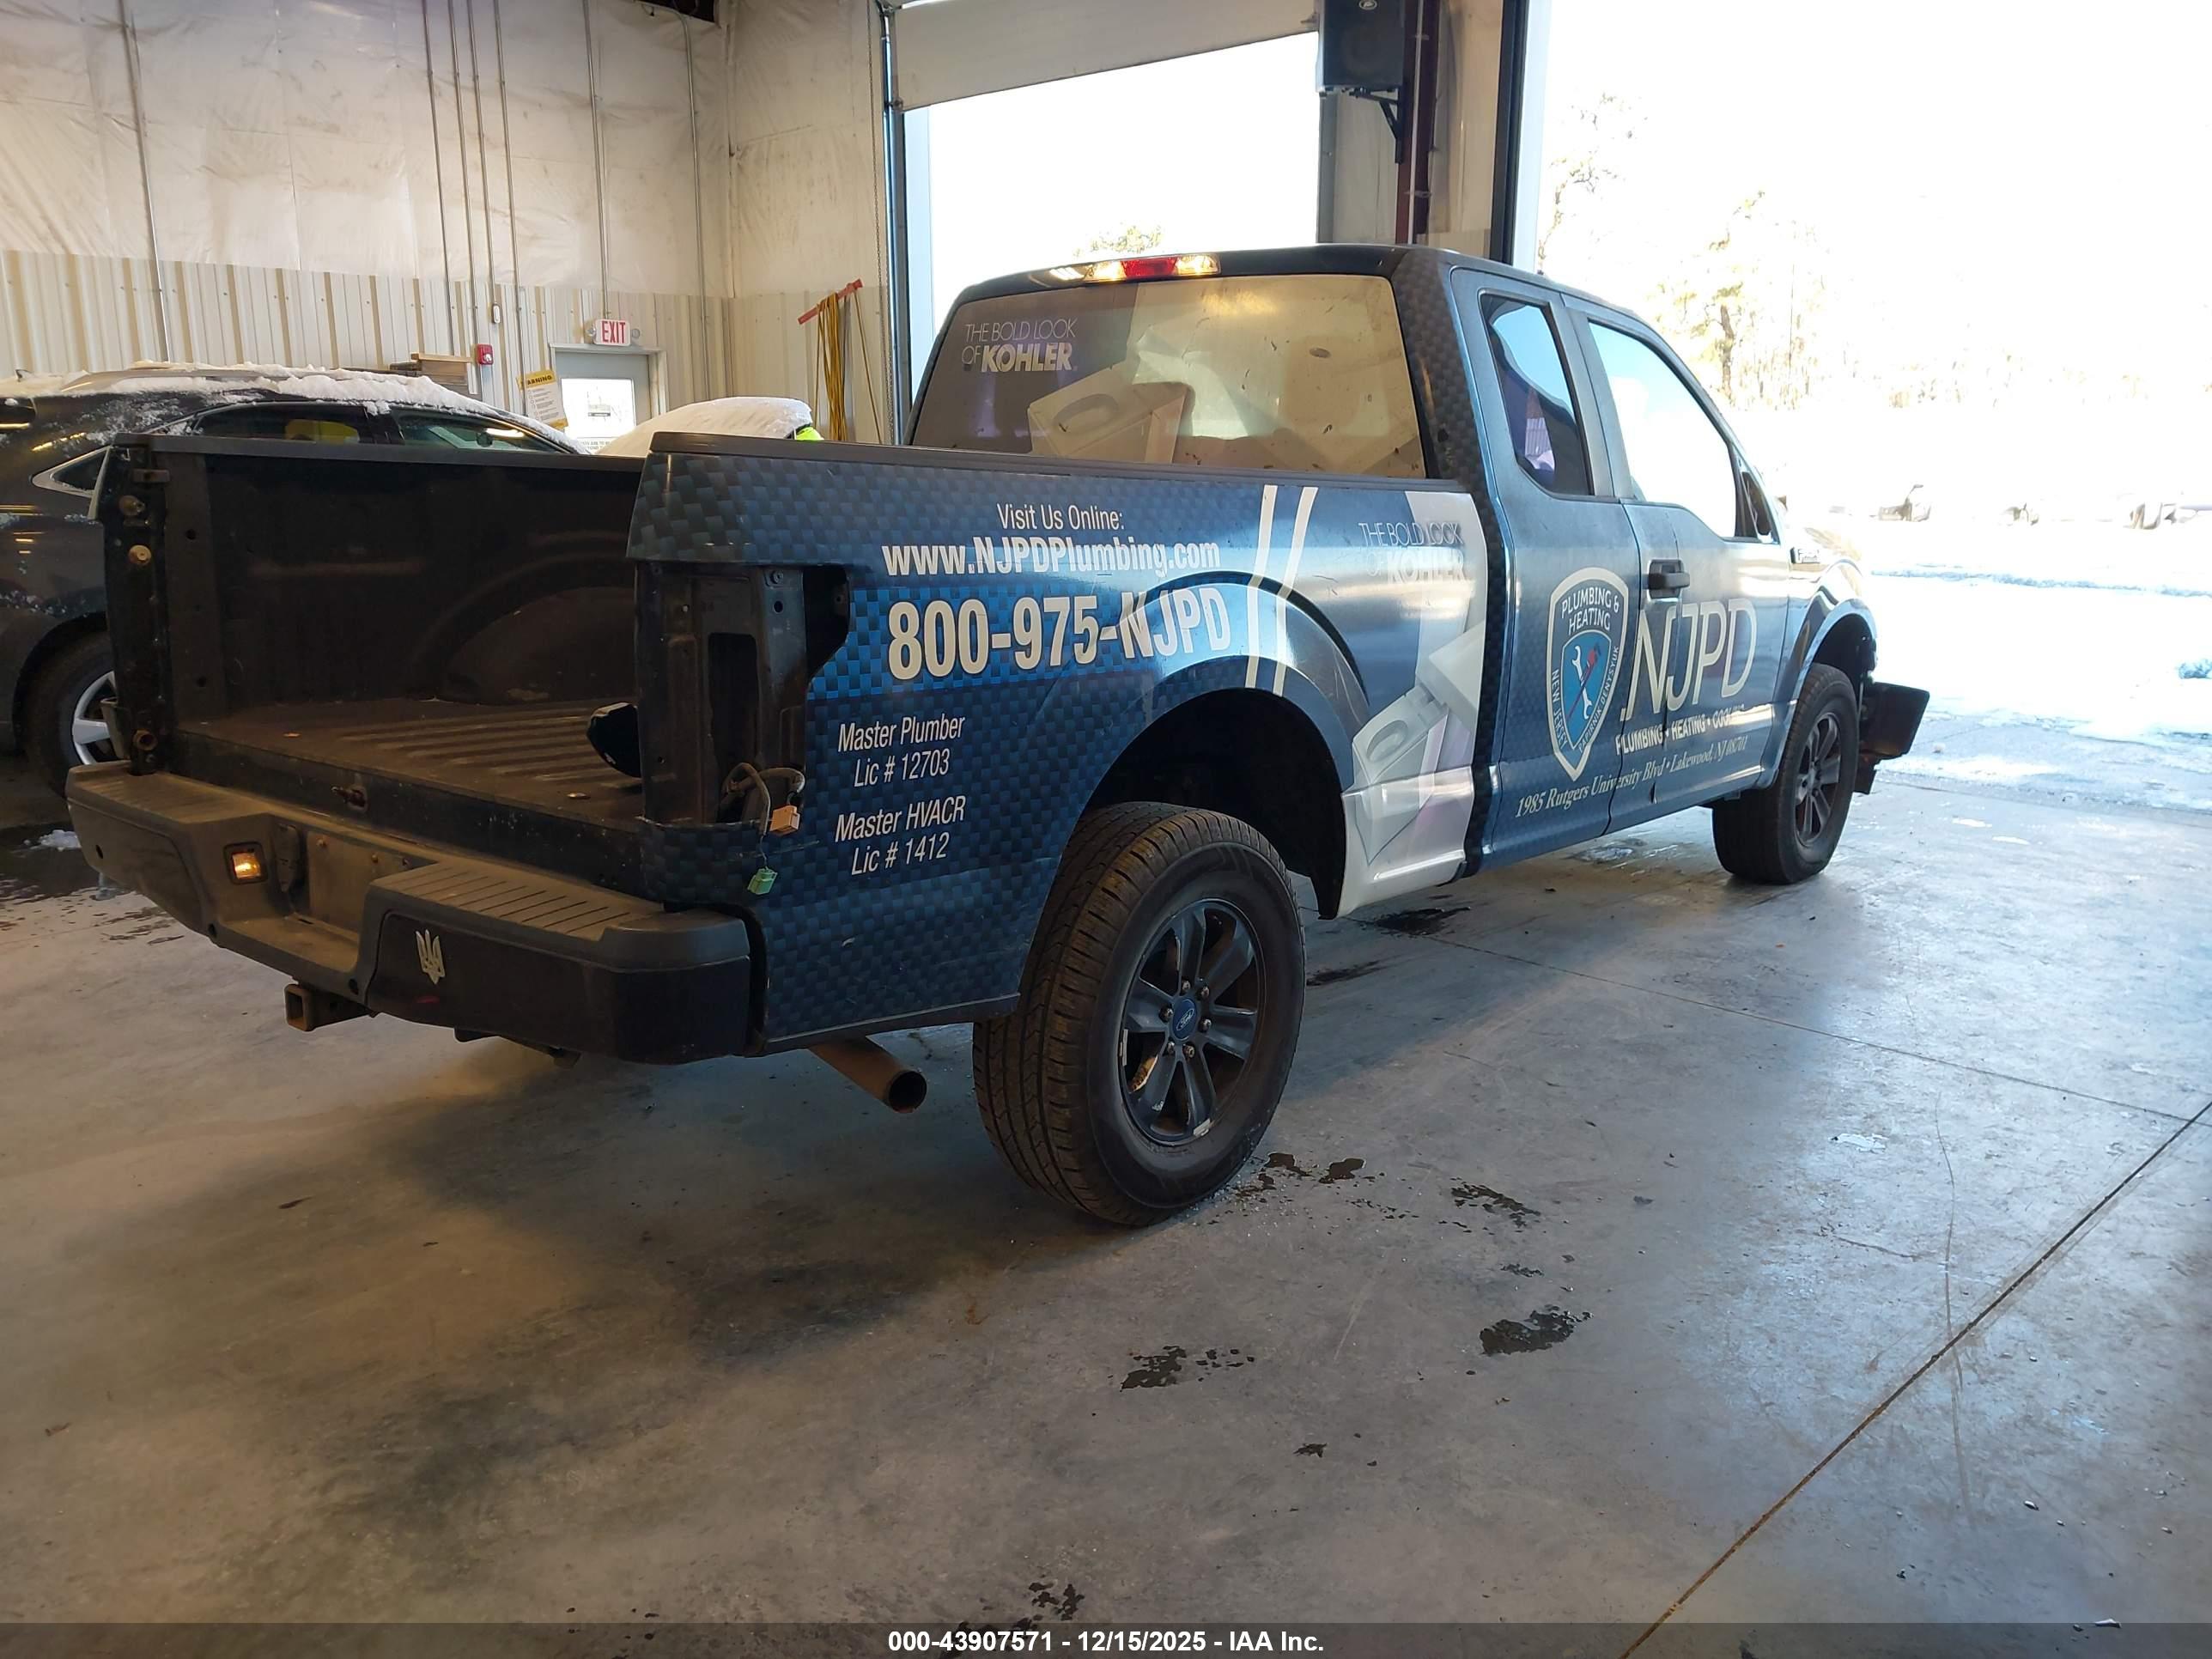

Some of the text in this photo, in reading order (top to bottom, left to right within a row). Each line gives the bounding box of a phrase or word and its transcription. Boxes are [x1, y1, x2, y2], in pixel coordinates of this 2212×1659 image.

[602, 320, 625, 343] EXIT
[965, 318, 1077, 342] THE BOLD LOOK
[962, 342, 1072, 372] OF KOHLER
[521, 374, 552, 387] ARNING
[997, 503, 1124, 530] Visit Us Online:
[1358, 521, 1463, 546] THE BOLD LOOK
[882, 536, 1220, 578] www.NJPDPlumbing.com
[1387, 548, 1466, 583] KOHLER
[1561, 586, 1611, 618] PLUMBING
[888, 587, 1231, 680] 800-975-NJPD
[1568, 608, 1611, 635] HEATING
[1620, 598, 1758, 721] NJPD
[1552, 669, 1568, 750] NEW JERSEY
[838, 714, 965, 752] Master Plumber
[1615, 724, 1663, 756] PLUMBING
[1671, 714, 1705, 740] HEATING
[854, 748, 950, 787] Lic # 12703
[1516, 792, 1547, 817] 1985
[1546, 785, 1589, 810] Rutgers
[1591, 767, 1642, 795] University
[1642, 757, 1664, 783] Blvd
[835, 795, 965, 842] Master HVACR
[851, 832, 950, 875] Lic # 1412
